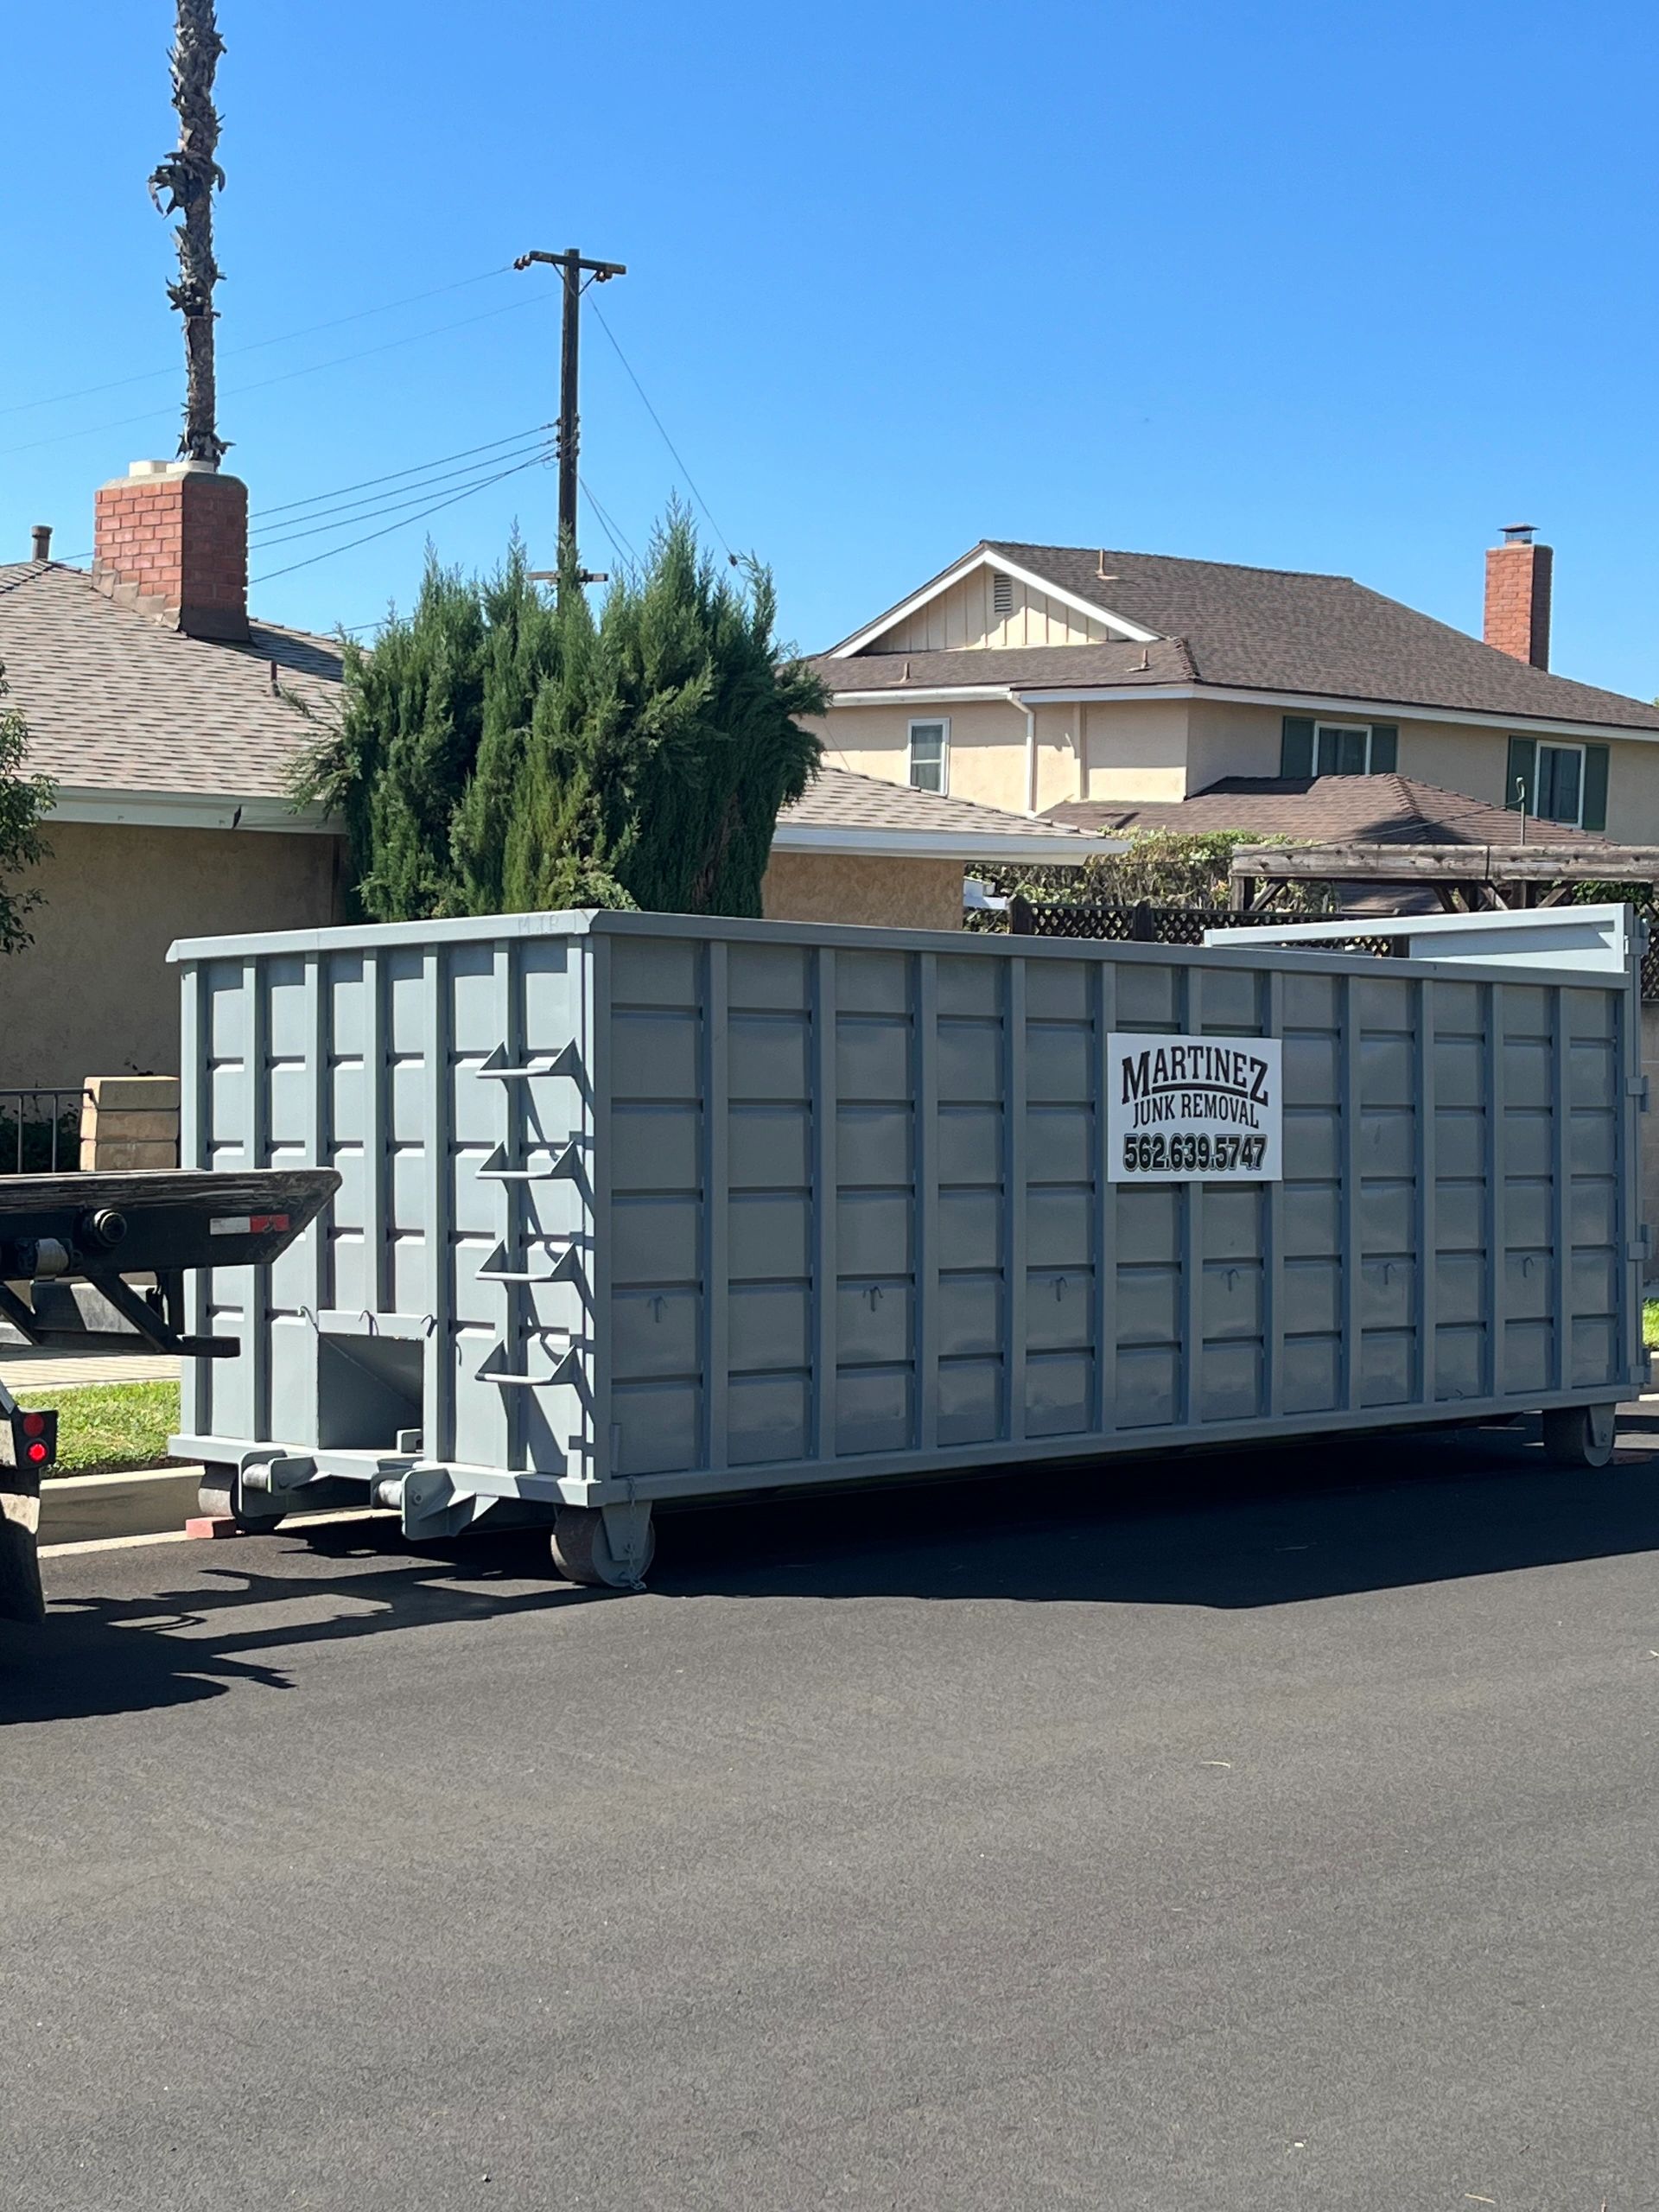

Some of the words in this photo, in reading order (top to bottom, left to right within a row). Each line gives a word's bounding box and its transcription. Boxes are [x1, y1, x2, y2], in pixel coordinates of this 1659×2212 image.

[1122, 1046, 1268, 1107] MARTINEZ
[1133, 1094, 1176, 1128] JUNK
[1181, 1093, 1259, 1129] REMOVAL
[1123, 1133, 1268, 1172] 562.639.5747
